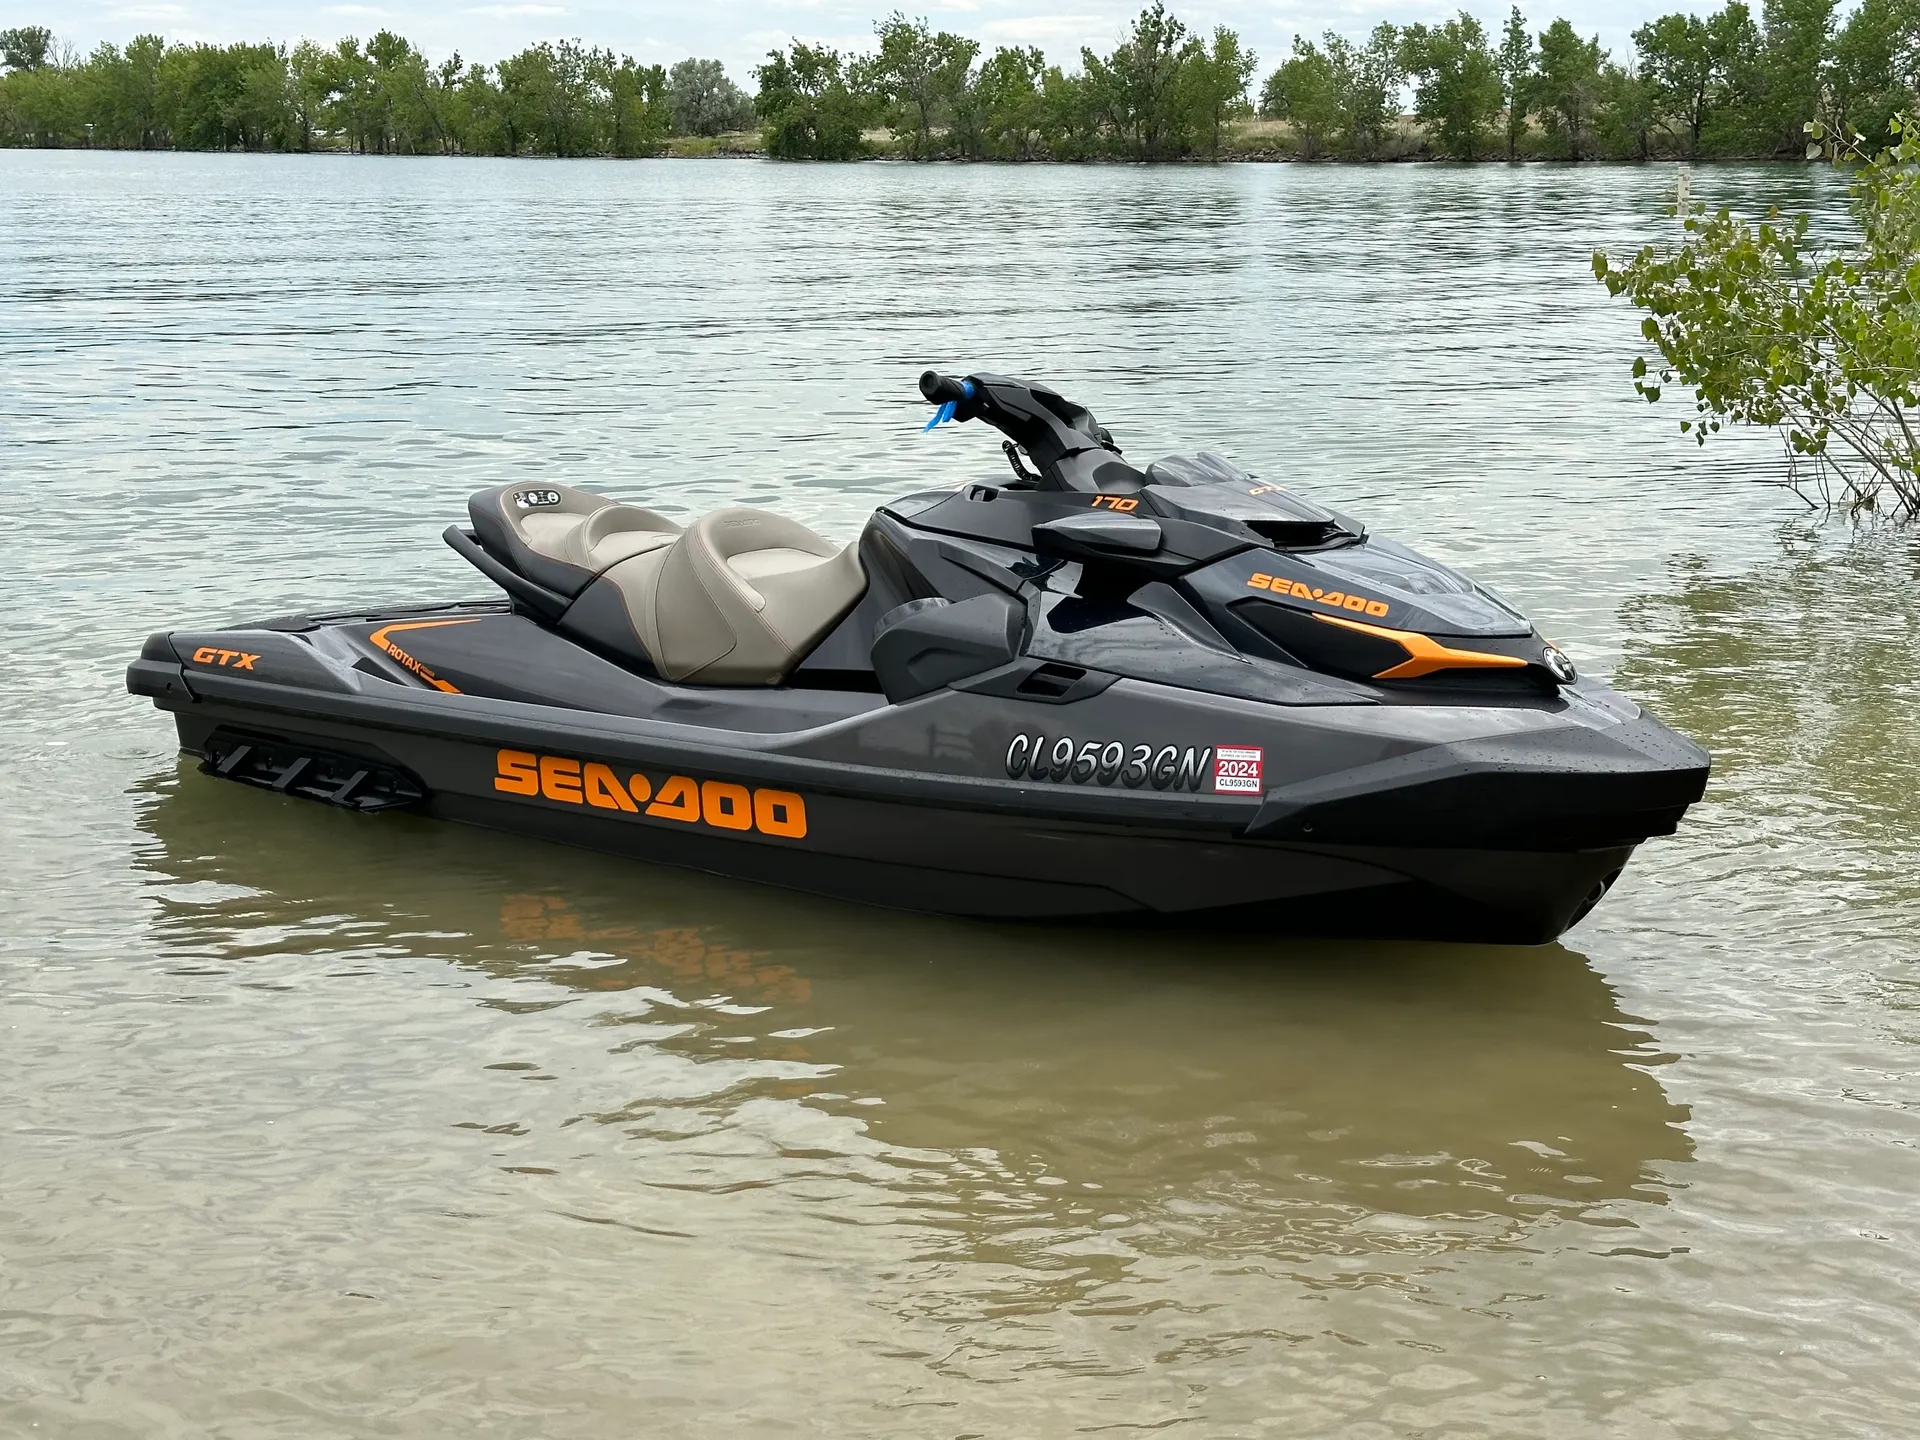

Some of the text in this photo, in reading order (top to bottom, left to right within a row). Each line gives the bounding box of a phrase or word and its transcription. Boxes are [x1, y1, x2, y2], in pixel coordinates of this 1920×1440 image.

[1091, 495, 1139, 511] 170
[192, 647, 262, 670] GTX
[387, 643, 421, 674] ROTAX
[1005, 732, 1213, 793] CL9593GN
[1218, 760, 1259, 777] 2024
[1219, 778, 1258, 788] CL9593GN
